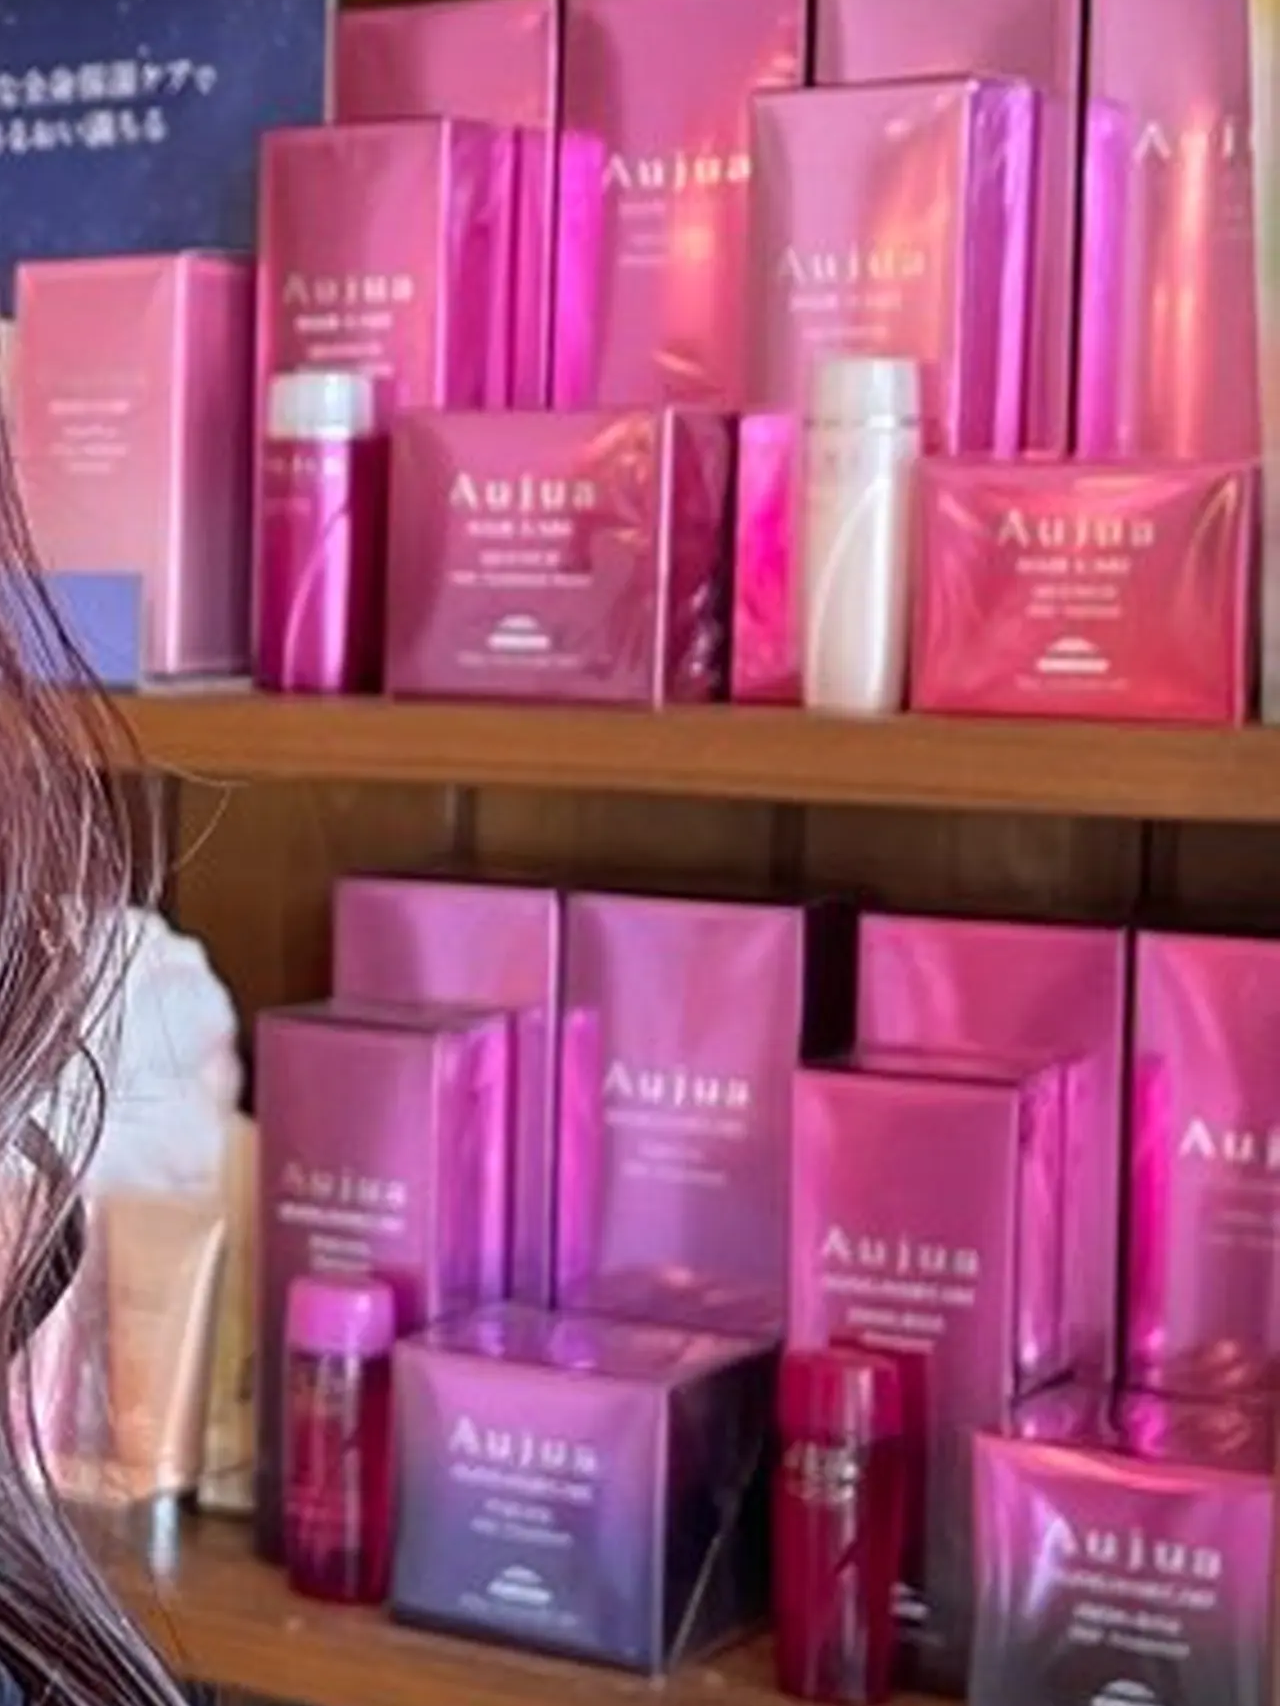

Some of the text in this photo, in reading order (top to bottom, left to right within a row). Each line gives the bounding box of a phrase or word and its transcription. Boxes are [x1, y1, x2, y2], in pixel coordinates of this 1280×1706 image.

[448, 471, 598, 514] Aujua
[997, 507, 1157, 551] Aujua
[603, 1059, 751, 1108] Aujua
[821, 1224, 981, 1277] Aujua
[448, 1414, 599, 1477] Aujua
[1048, 1517, 1223, 1579] Aujua
